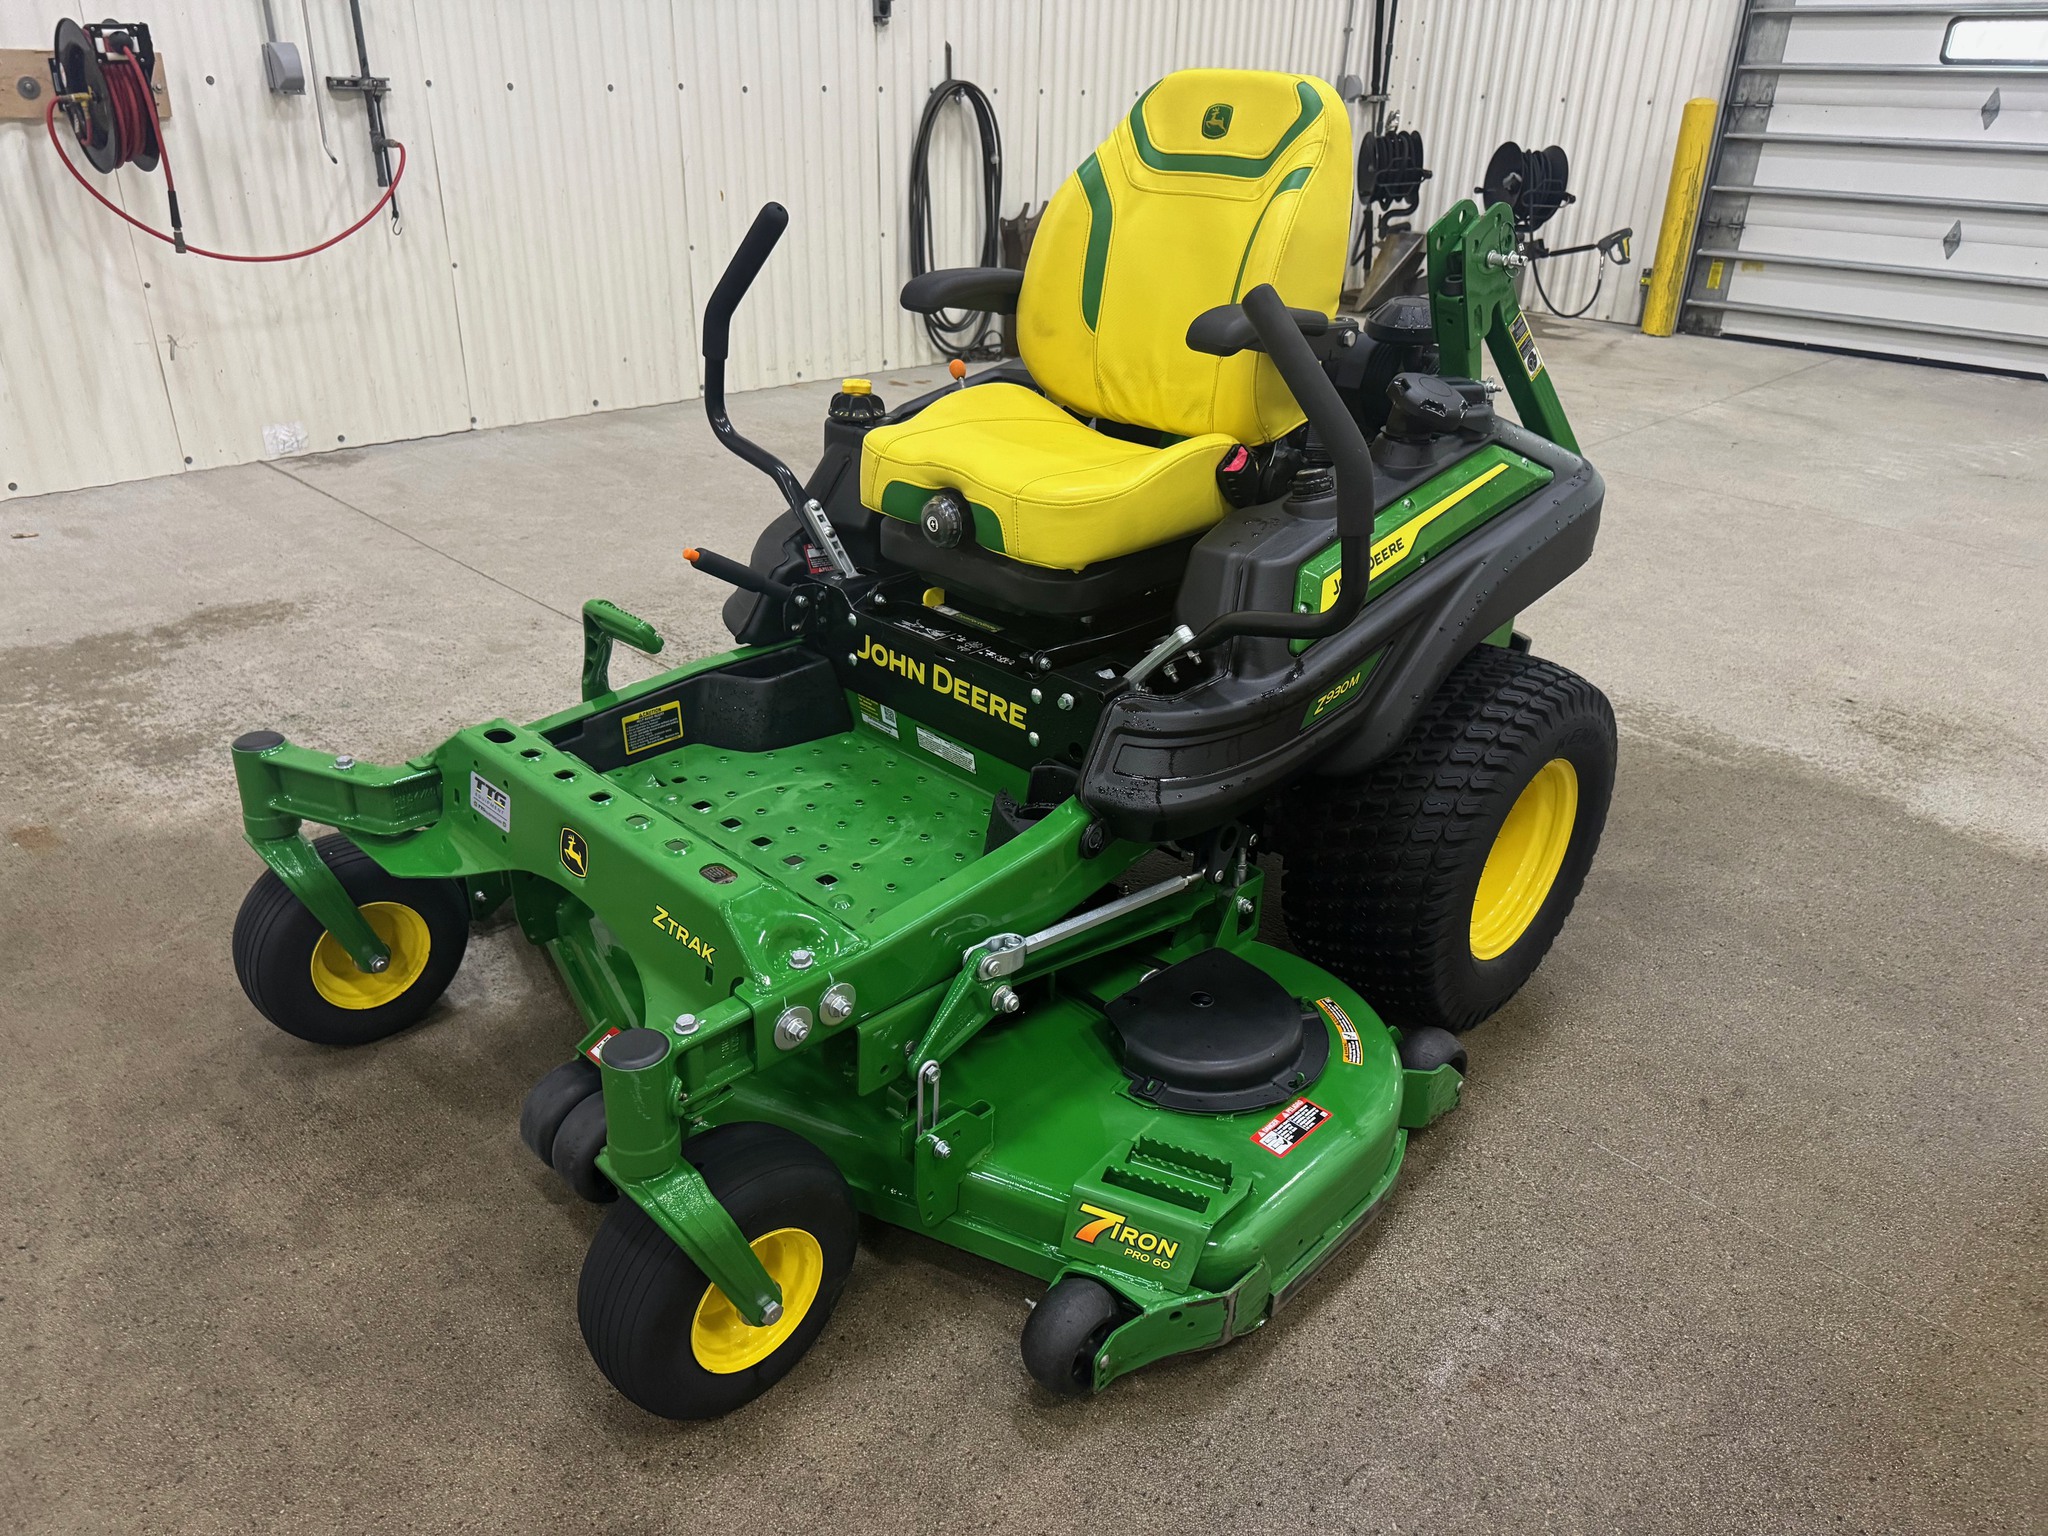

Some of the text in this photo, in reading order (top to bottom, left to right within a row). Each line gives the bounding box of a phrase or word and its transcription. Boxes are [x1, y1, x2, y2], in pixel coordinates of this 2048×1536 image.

[857, 634, 926, 686] JOHN
[932, 663, 1027, 731] DEERE
[1313, 672, 1361, 715] Z930M
[474, 776, 507, 810] TTG
[474, 792, 505, 815] EQUIPMENT
[652, 904, 717, 965] ZTRAK
[1124, 1247, 1171, 1270] PRO 60
